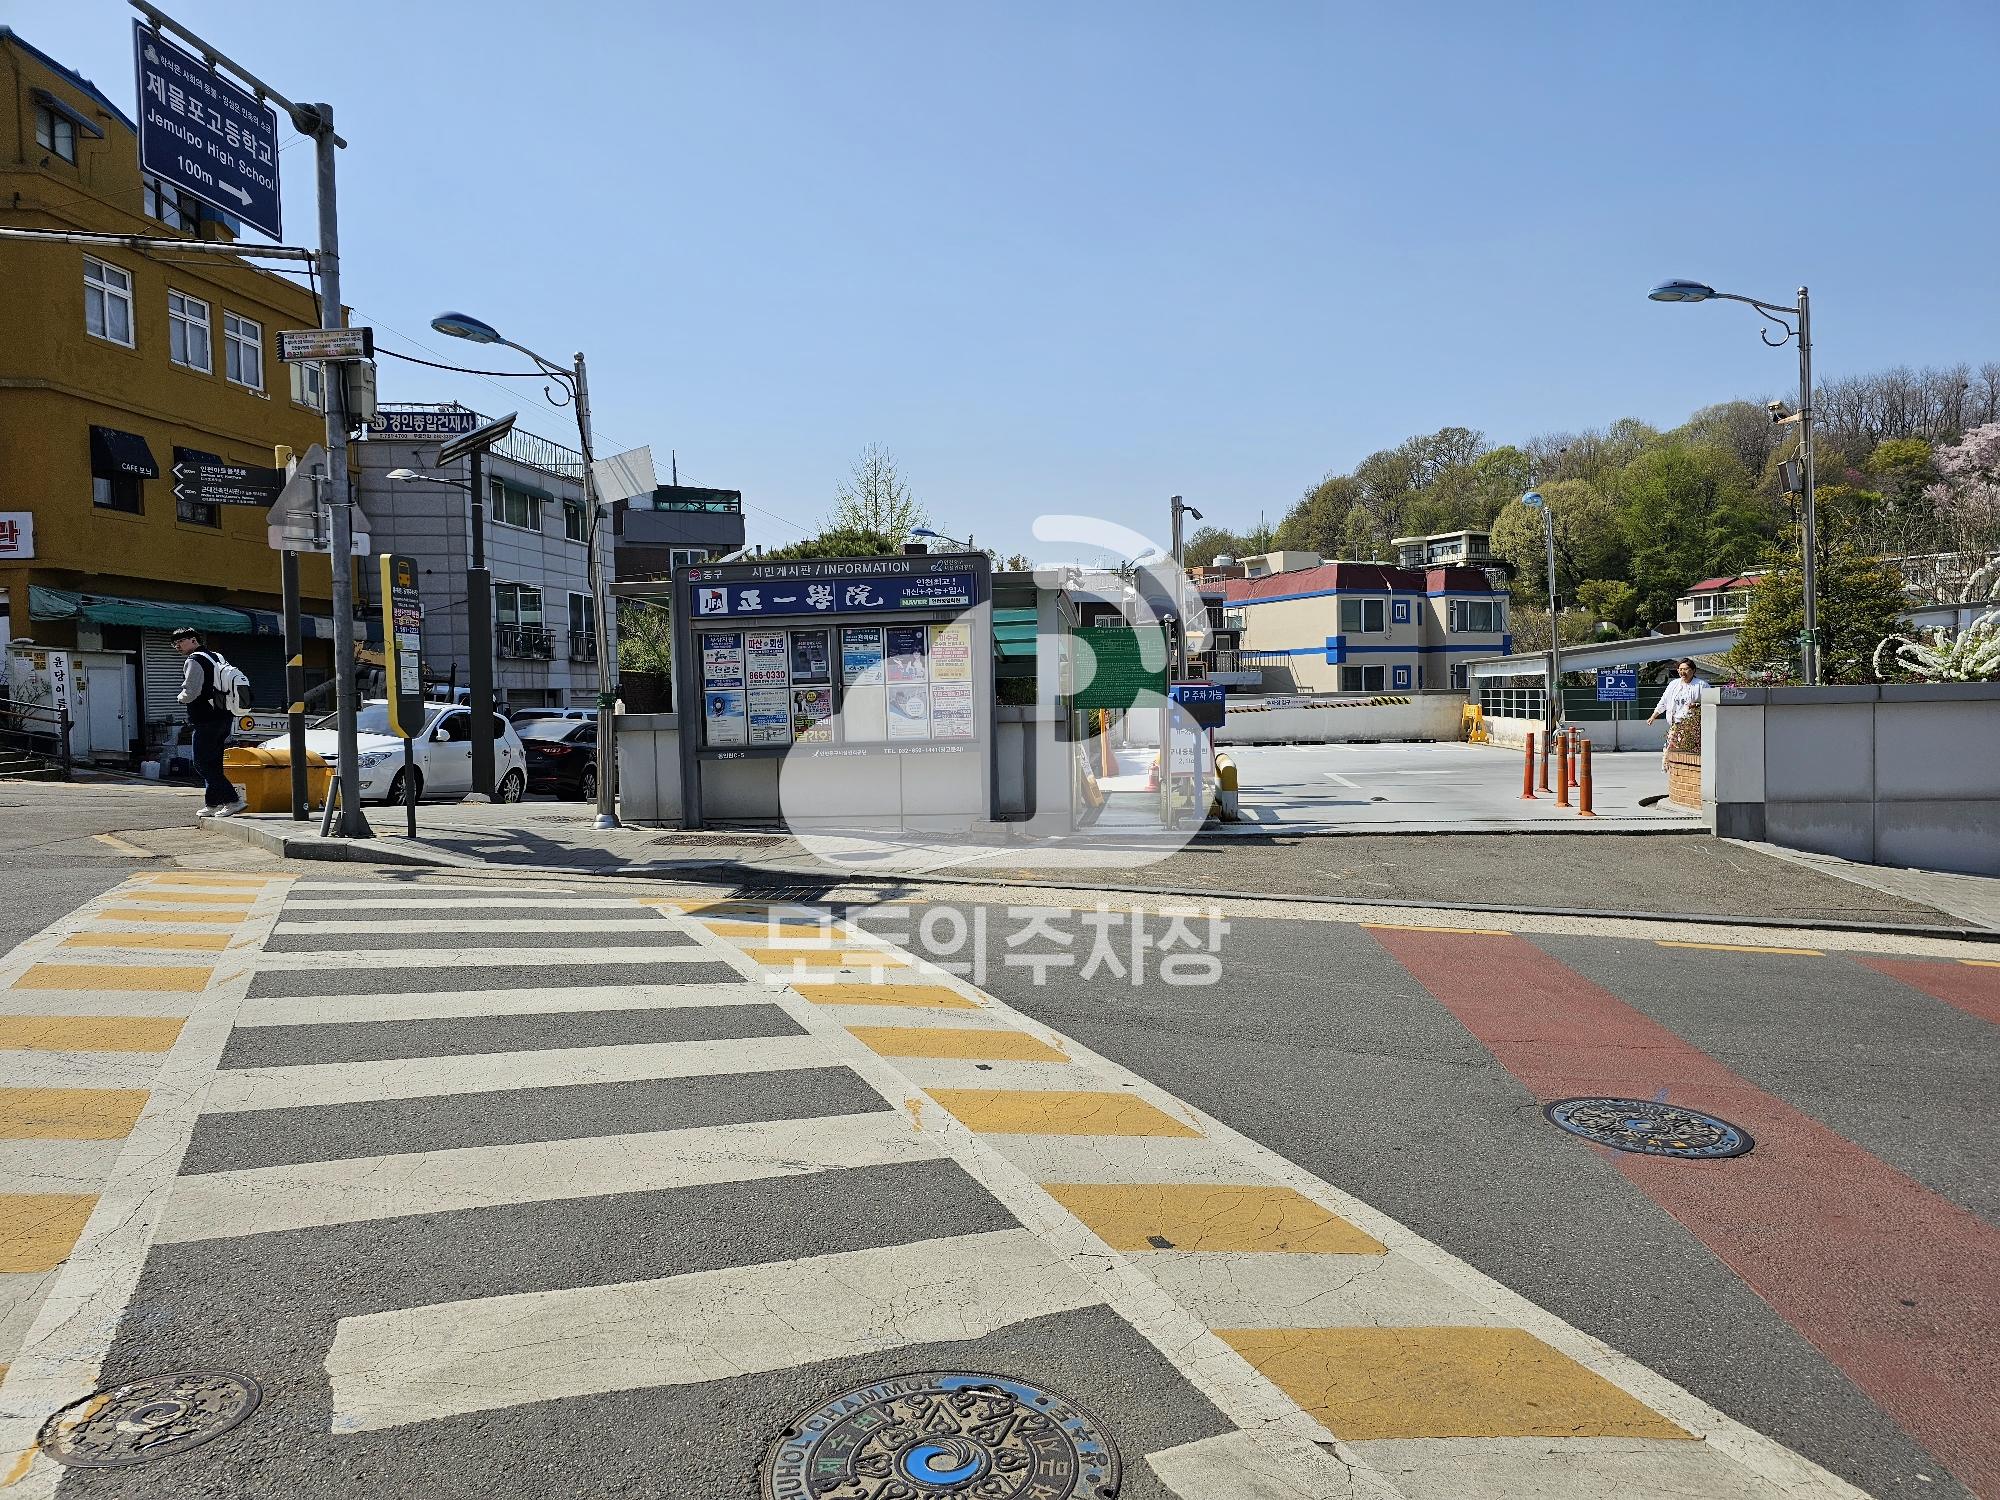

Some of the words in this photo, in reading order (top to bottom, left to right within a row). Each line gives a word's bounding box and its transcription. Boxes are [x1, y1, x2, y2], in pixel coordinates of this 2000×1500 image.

[146, 70, 273, 167] 제물포고등학교
[147, 108, 203, 149] Jemulpo
[207, 140, 234, 168] High
[238, 160, 275, 191] School
[178, 155, 213, 186] 100m
[389, 414, 474, 432] 경인종합건재사
[121, 462, 138, 472] CAFE
[703, 569, 723, 580] 중구
[752, 564, 812, 580] 시민게시판
[824, 561, 910, 575] INFORMATION
[748, 638, 764, 650] 파산
[769, 637, 784, 649] 회생
[749, 671, 786, 680] 866-0330
[1605, 676, 1615, 689] P
[1183, 690, 1190, 702] P
[1191, 690, 1206, 701] 주차
[1208, 690, 1223, 701] 가능
[804, 1378, 944, 1434] CHAMMUL
